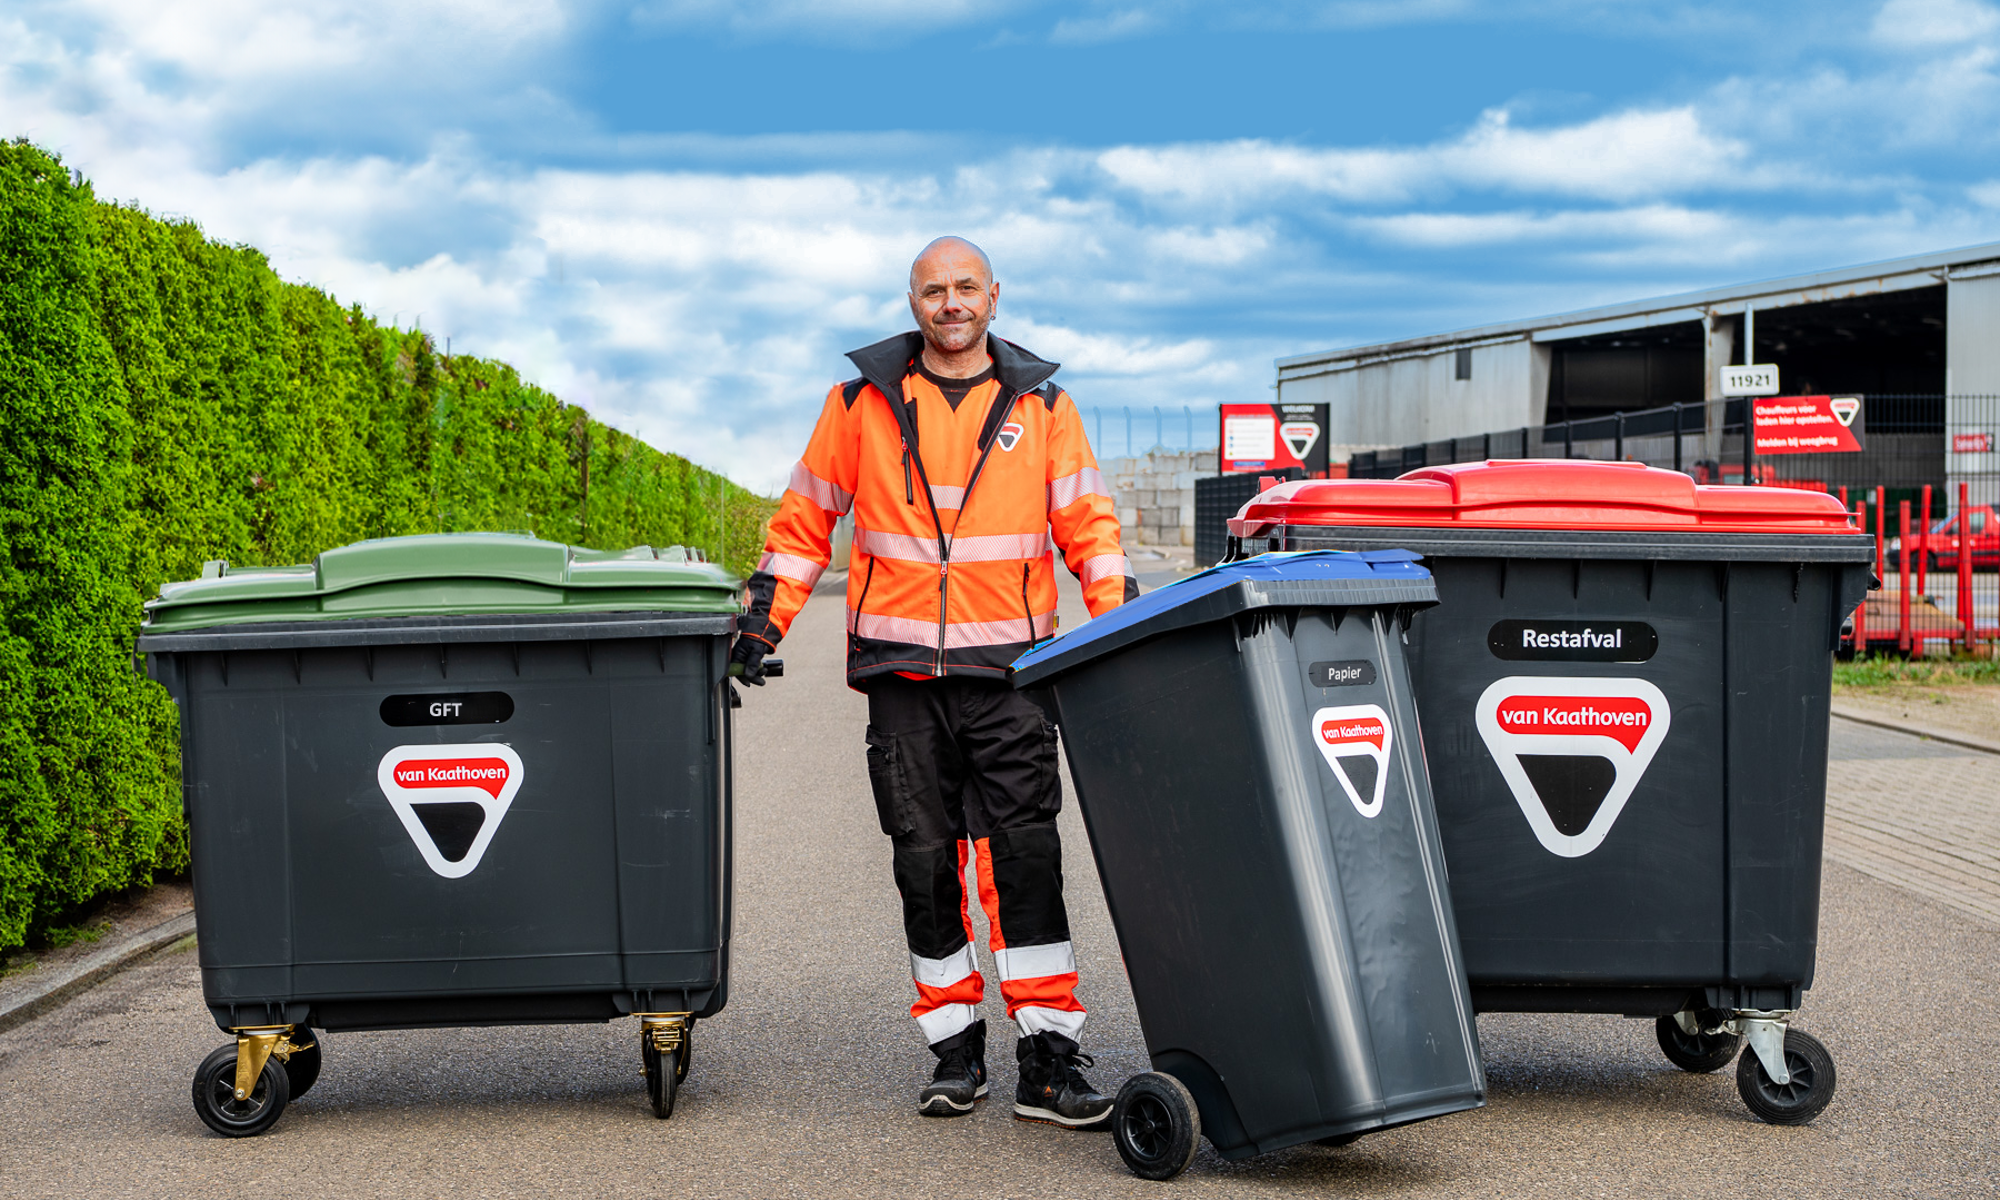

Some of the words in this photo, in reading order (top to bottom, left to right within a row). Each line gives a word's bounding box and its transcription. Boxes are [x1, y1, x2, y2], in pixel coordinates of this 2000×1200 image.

[1729, 374, 1771, 388] 11921
[1755, 405, 1798, 415] Chauffeurs
[1798, 405, 1817, 414] voor
[1755, 416, 1779, 426] laden
[1779, 415, 1795, 425] hier
[1756, 437, 1787, 448] Melden
[1787, 436, 1799, 448] bij
[1799, 435, 1839, 447] weegbrug
[1522, 628, 1622, 648] Restafval
[1328, 666, 1362, 682] Papier
[429, 702, 462, 717] GFT
[1502, 710, 1538, 725] van
[1543, 707, 1647, 726] Kaathoven
[1323, 728, 1340, 739] van
[1340, 725, 1384, 738] Kaathoven
[397, 768, 425, 782] van
[428, 766, 506, 781] Kaathoven
